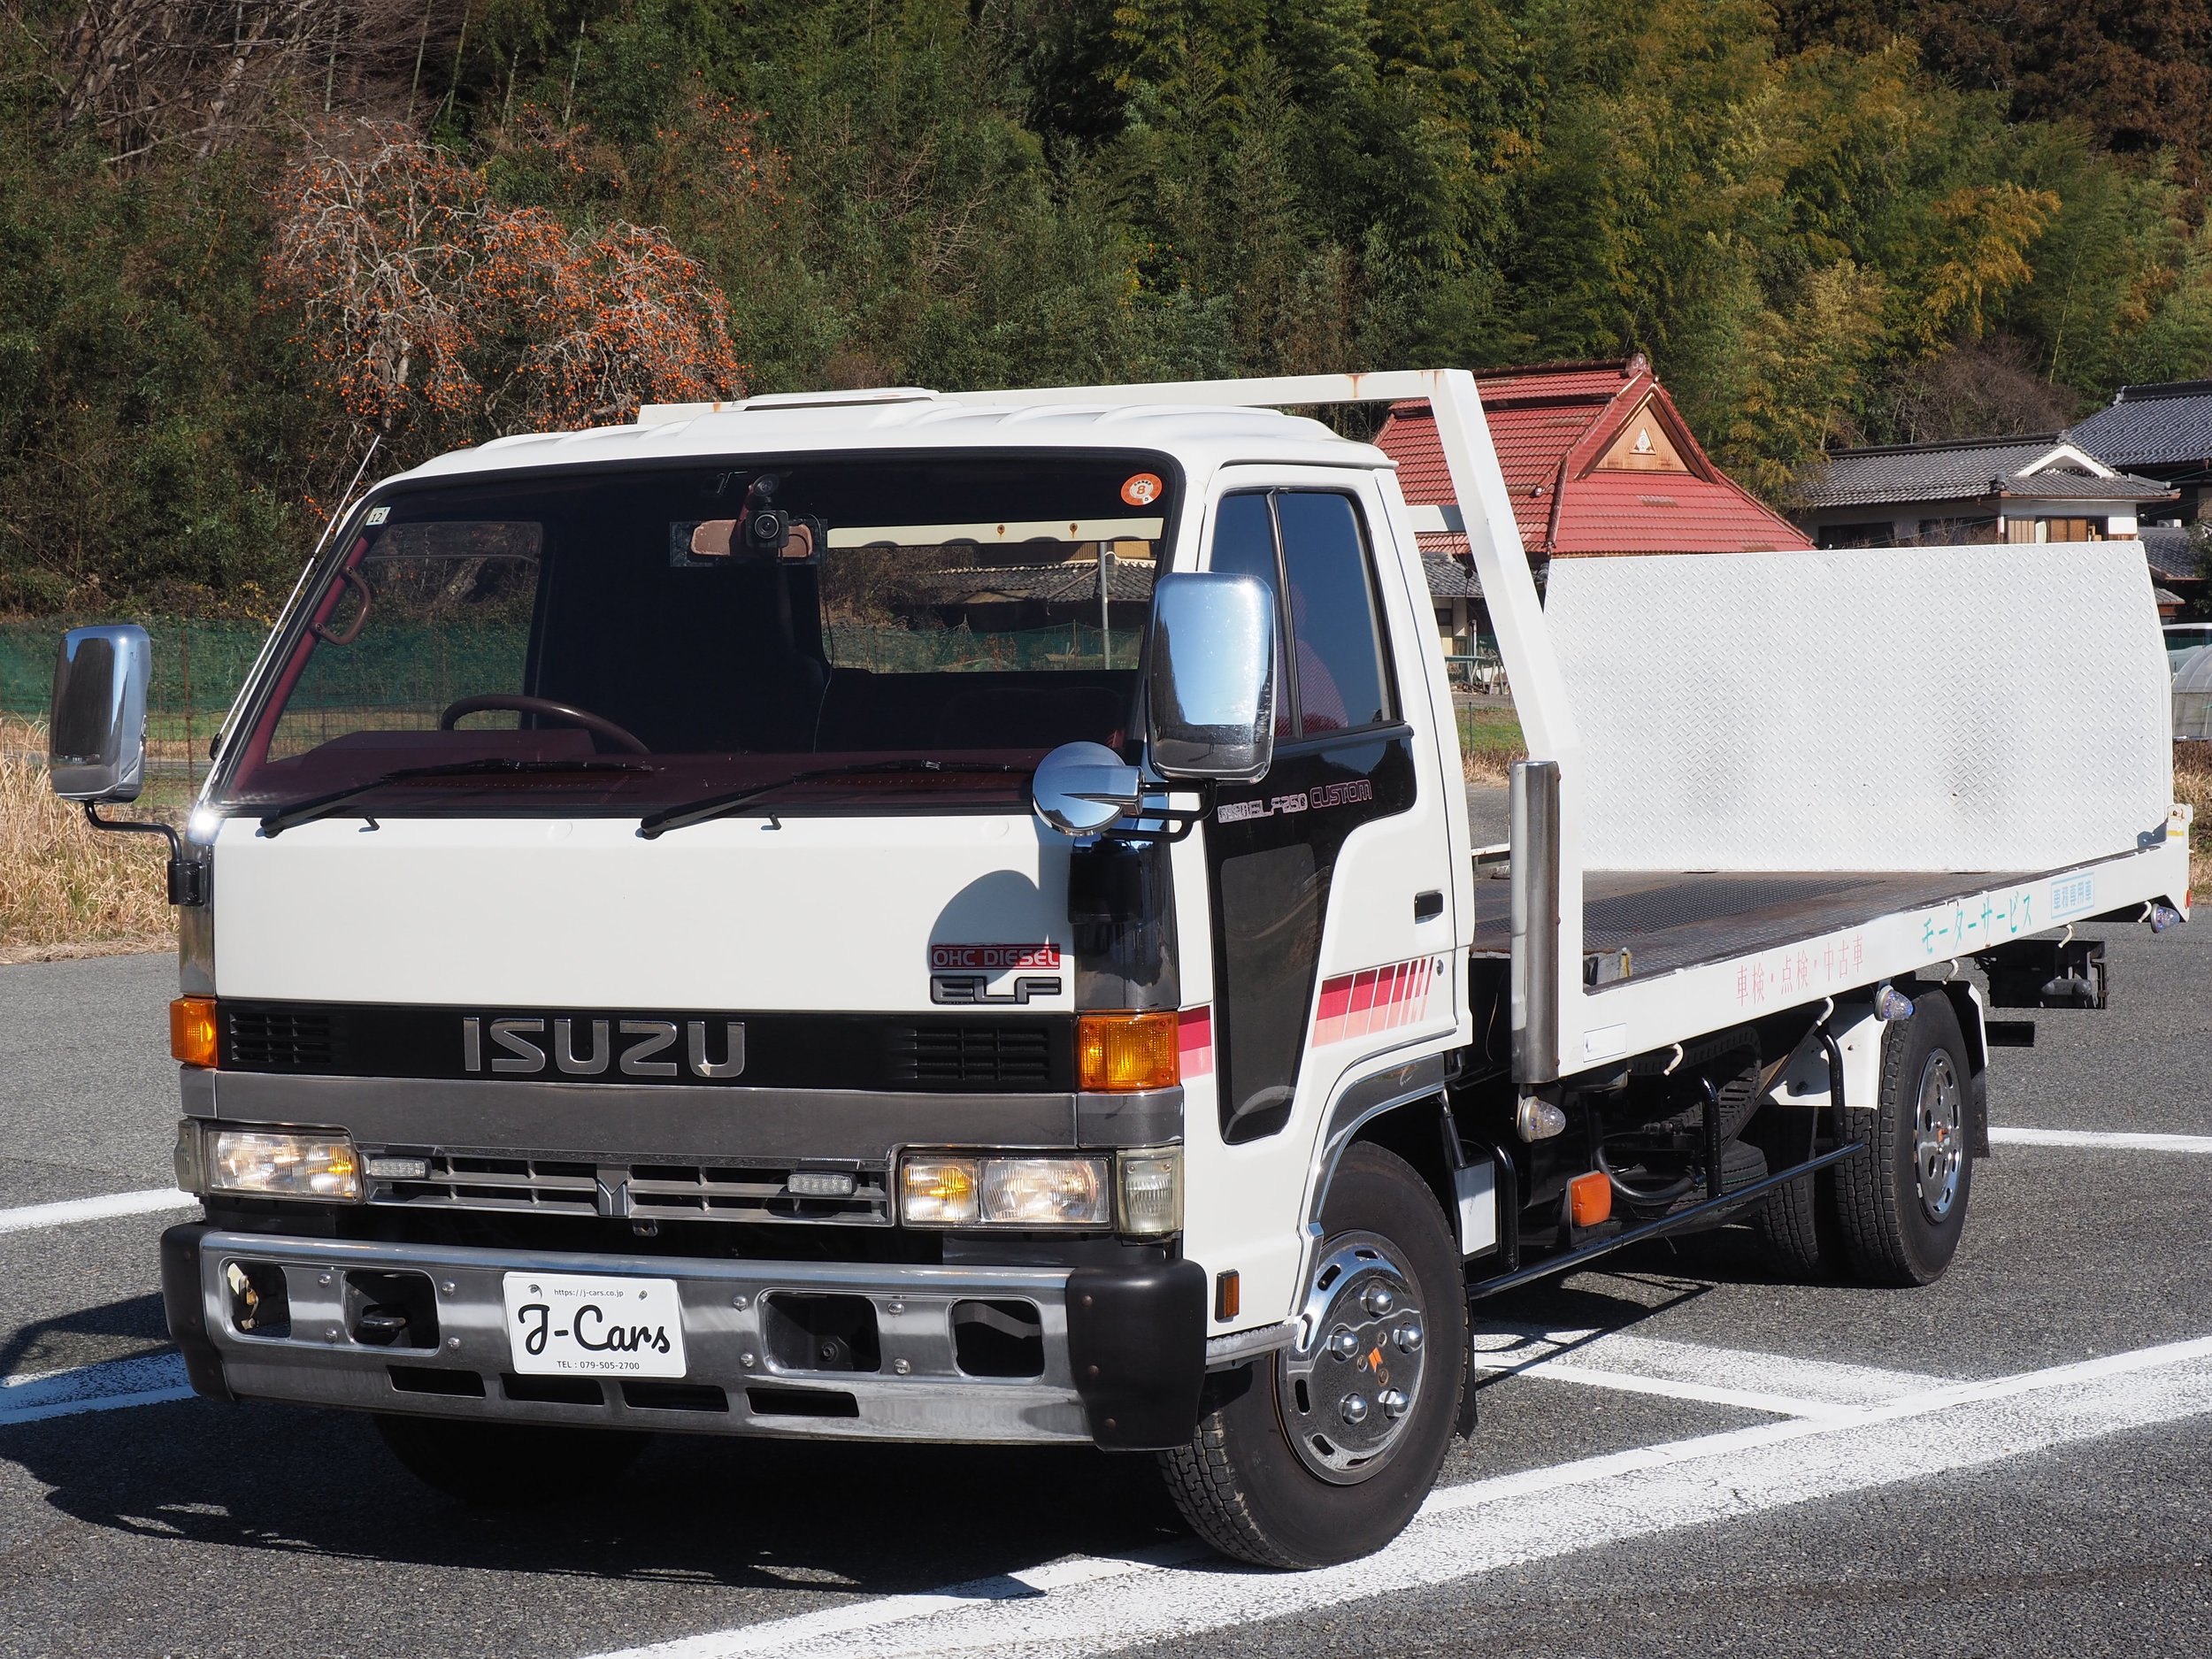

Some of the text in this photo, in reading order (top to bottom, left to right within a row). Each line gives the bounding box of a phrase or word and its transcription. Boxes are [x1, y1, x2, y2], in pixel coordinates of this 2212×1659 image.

[370, 512, 383, 523] 12
[1310, 779, 1372, 809] CUSTOM
[1922, 890, 2032, 954] モーターサービス
[933, 949, 1059, 966] OHC DIESEL
[1736, 933, 1863, 1007] 車検・点検・中古車
[930, 976, 1062, 1004] ELF
[464, 1018, 745, 1078] ISUZU
[554, 1288, 624, 1298] https://j-cars.co.jp
[518, 1303, 671, 1356] J-Cars
[580, 1361, 640, 1370] 079-505-2700
